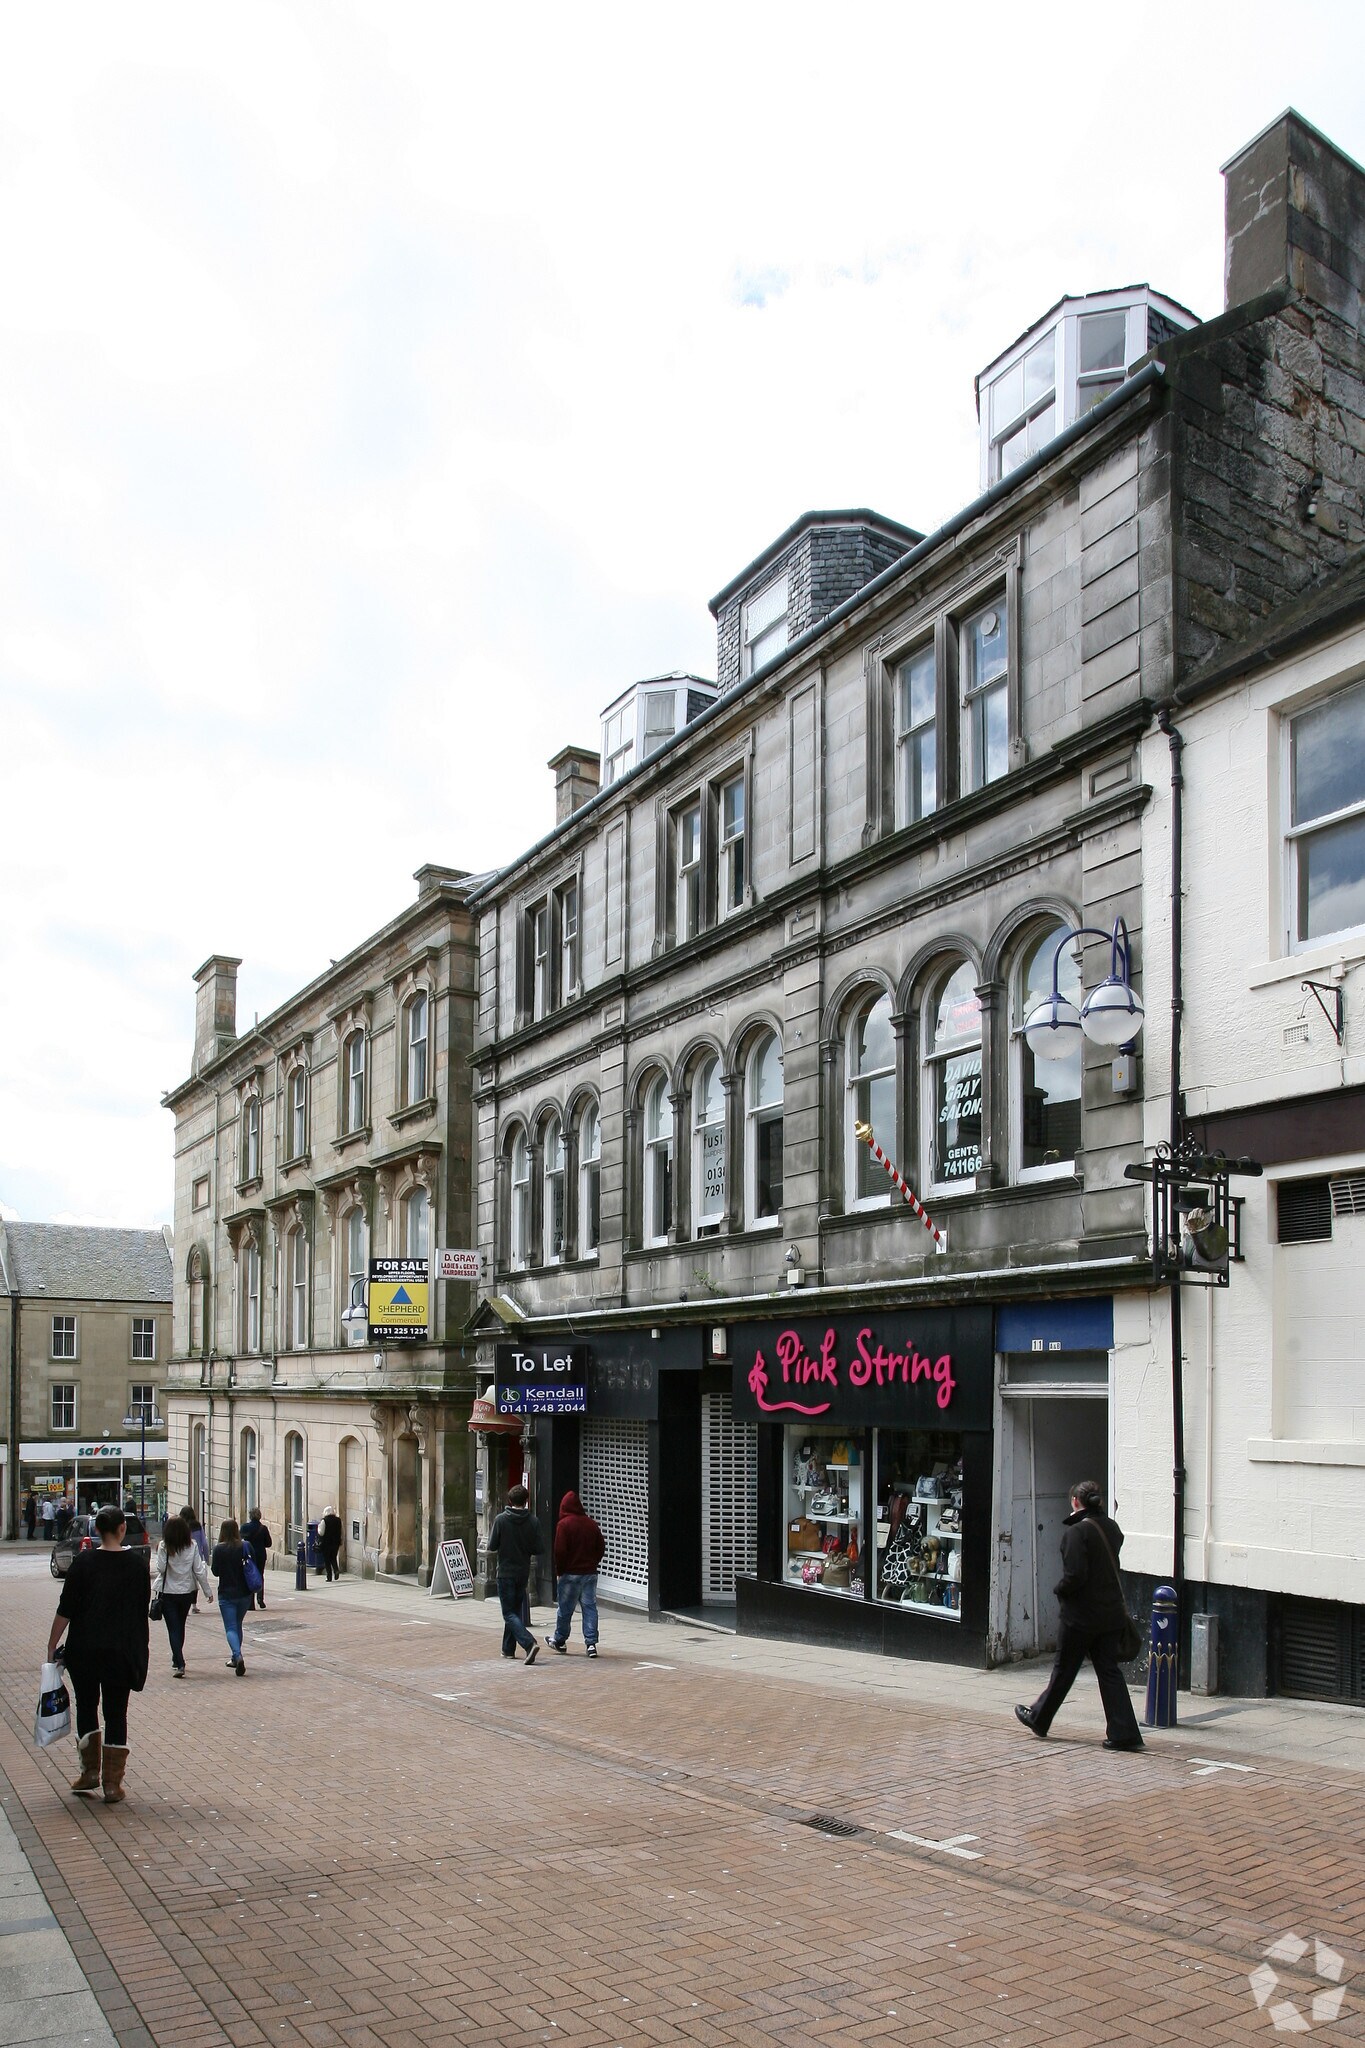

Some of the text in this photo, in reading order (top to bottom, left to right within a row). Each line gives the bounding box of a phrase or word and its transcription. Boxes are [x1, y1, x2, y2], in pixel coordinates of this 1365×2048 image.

[944, 1060, 982, 1082] DAVID
[945, 1078, 981, 1102] GRAY
[704, 1130, 725, 1149] fusi
[948, 1145, 978, 1159] GENTS
[944, 1156, 982, 1176] 741166
[444, 1253, 475, 1262] D. GRAY
[376, 1261, 428, 1270] FOR SALE
[378, 1305, 425, 1313] SHEPHERD
[511, 1353, 572, 1371] To Let
[776, 1328, 956, 1408] Pink String
[526, 1387, 584, 1398] Kendall
[500, 1403, 585, 1412] 0141 248 2044
[78, 1444, 122, 1455] savers
[445, 1546, 461, 1556] DAVID
[449, 1557, 464, 1568] GRAY
